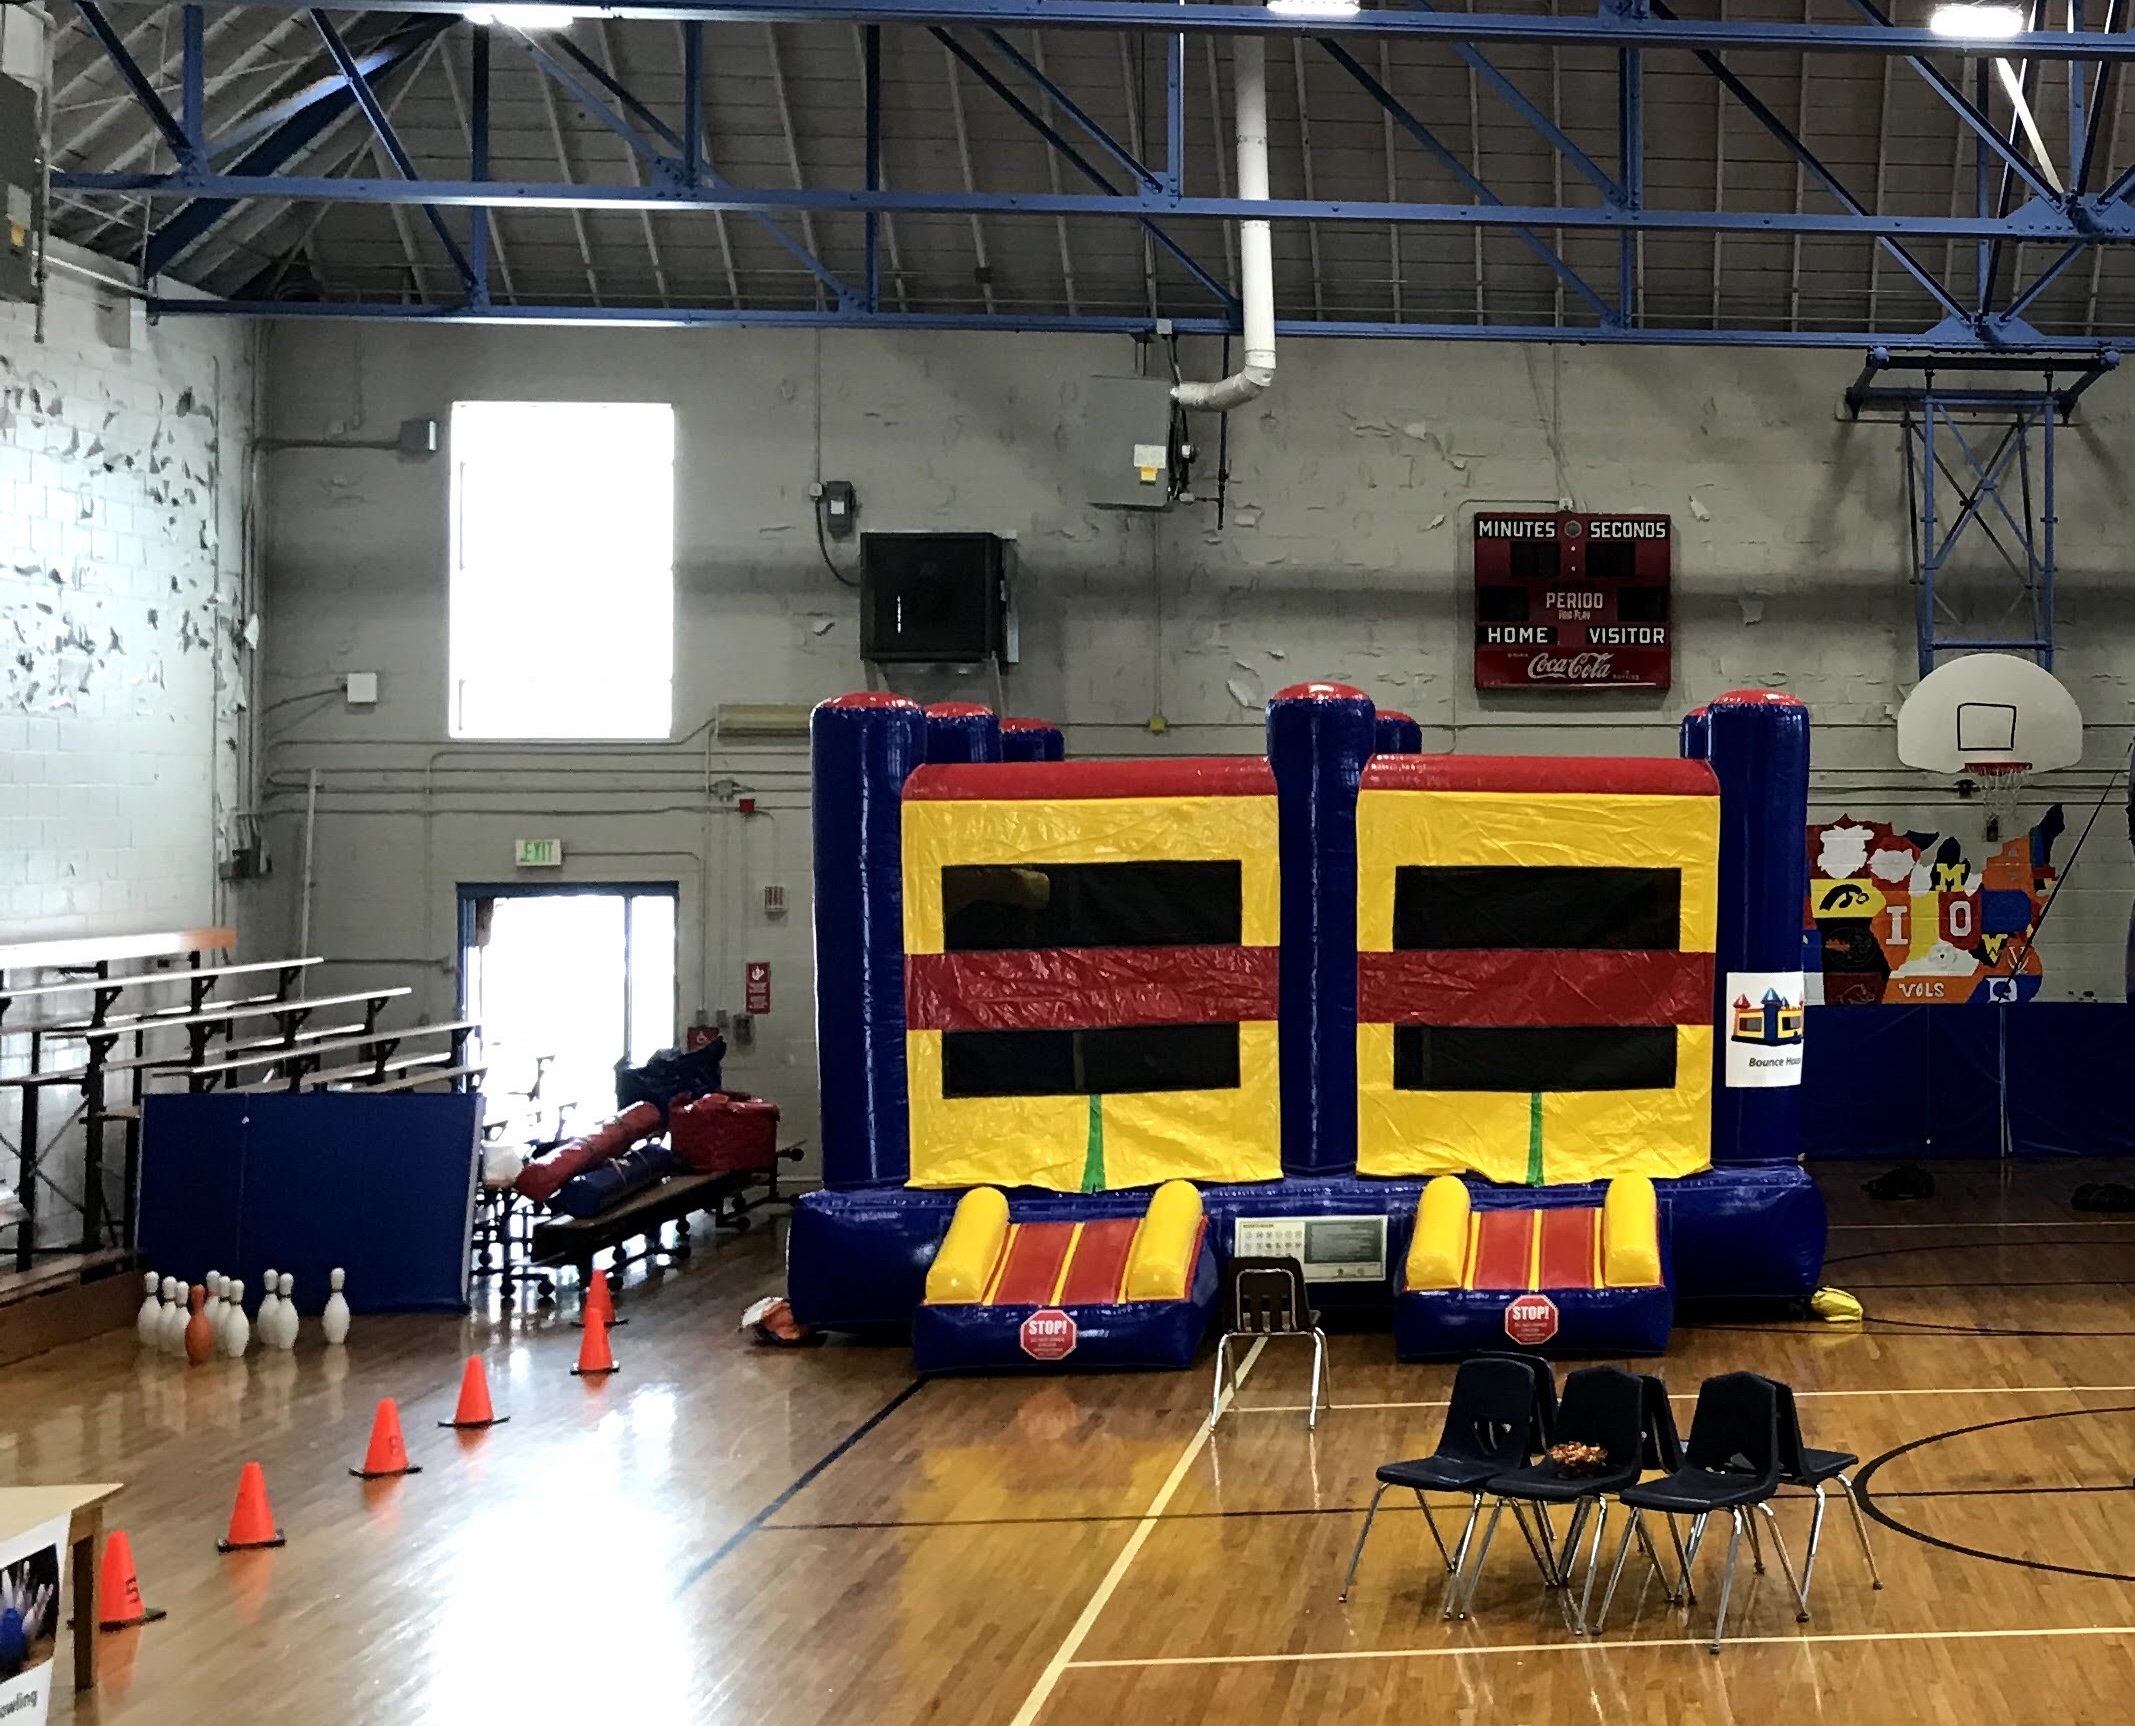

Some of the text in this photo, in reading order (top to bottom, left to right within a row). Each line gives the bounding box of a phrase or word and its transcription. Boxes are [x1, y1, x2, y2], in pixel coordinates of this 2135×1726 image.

[1479, 520, 1666, 539] MINUTES SECONDS
[1546, 592, 1603, 609] PERIOD
[1488, 627, 1665, 644] HOME VISITOR
[1527, 652, 1615, 679] Coca-Cola
[521, 840, 554, 862] EXIT
[1935, 863, 1966, 892] M
[1886, 906, 1908, 945] I
[1981, 933, 2009, 964] W
[1899, 982, 1945, 998] VOLS
[1748, 1057, 1785, 1068] Bounce
[1512, 1305, 1550, 1321] STOP!
[1028, 1319, 1068, 1336] STOP!
[125, 1576, 141, 1604] 5
